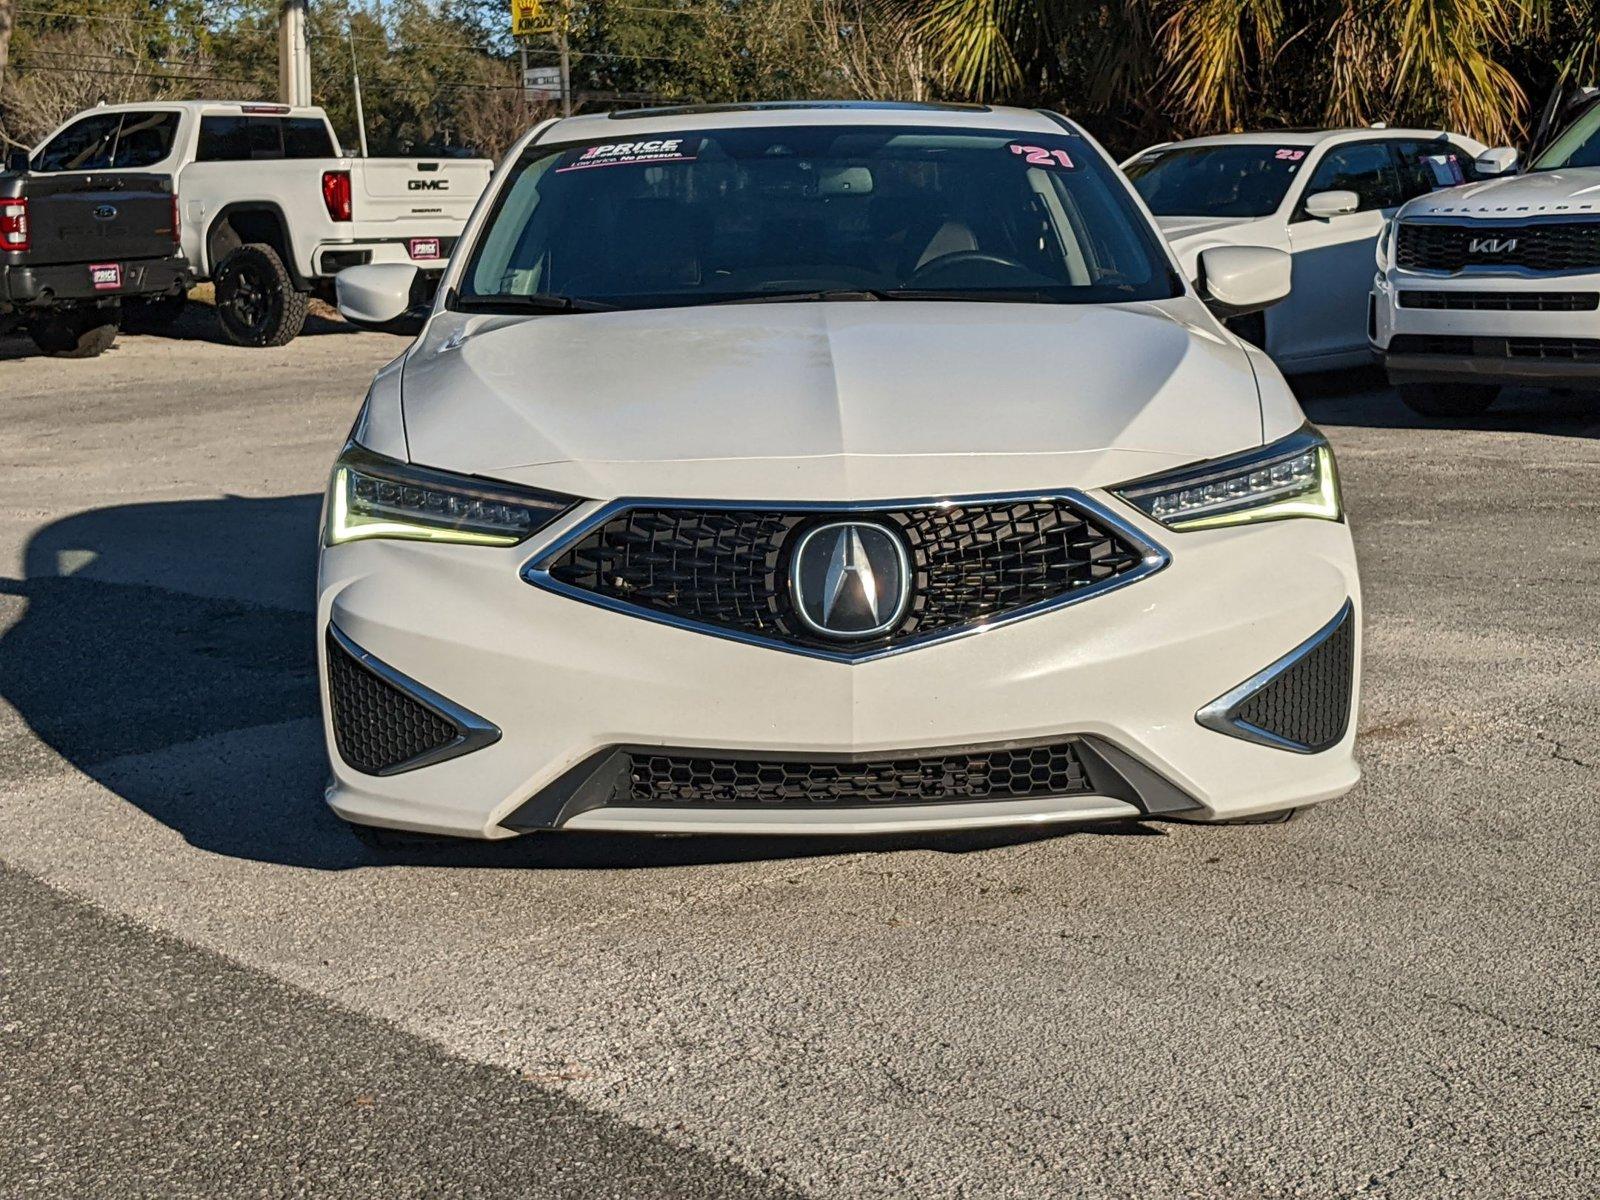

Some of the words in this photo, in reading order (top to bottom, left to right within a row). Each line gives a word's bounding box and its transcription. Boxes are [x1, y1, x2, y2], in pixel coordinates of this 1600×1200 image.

[518, 17, 554, 29] KINGDO
[408, 180, 449, 190] GMC
[1469, 238, 1518, 253] KIA
